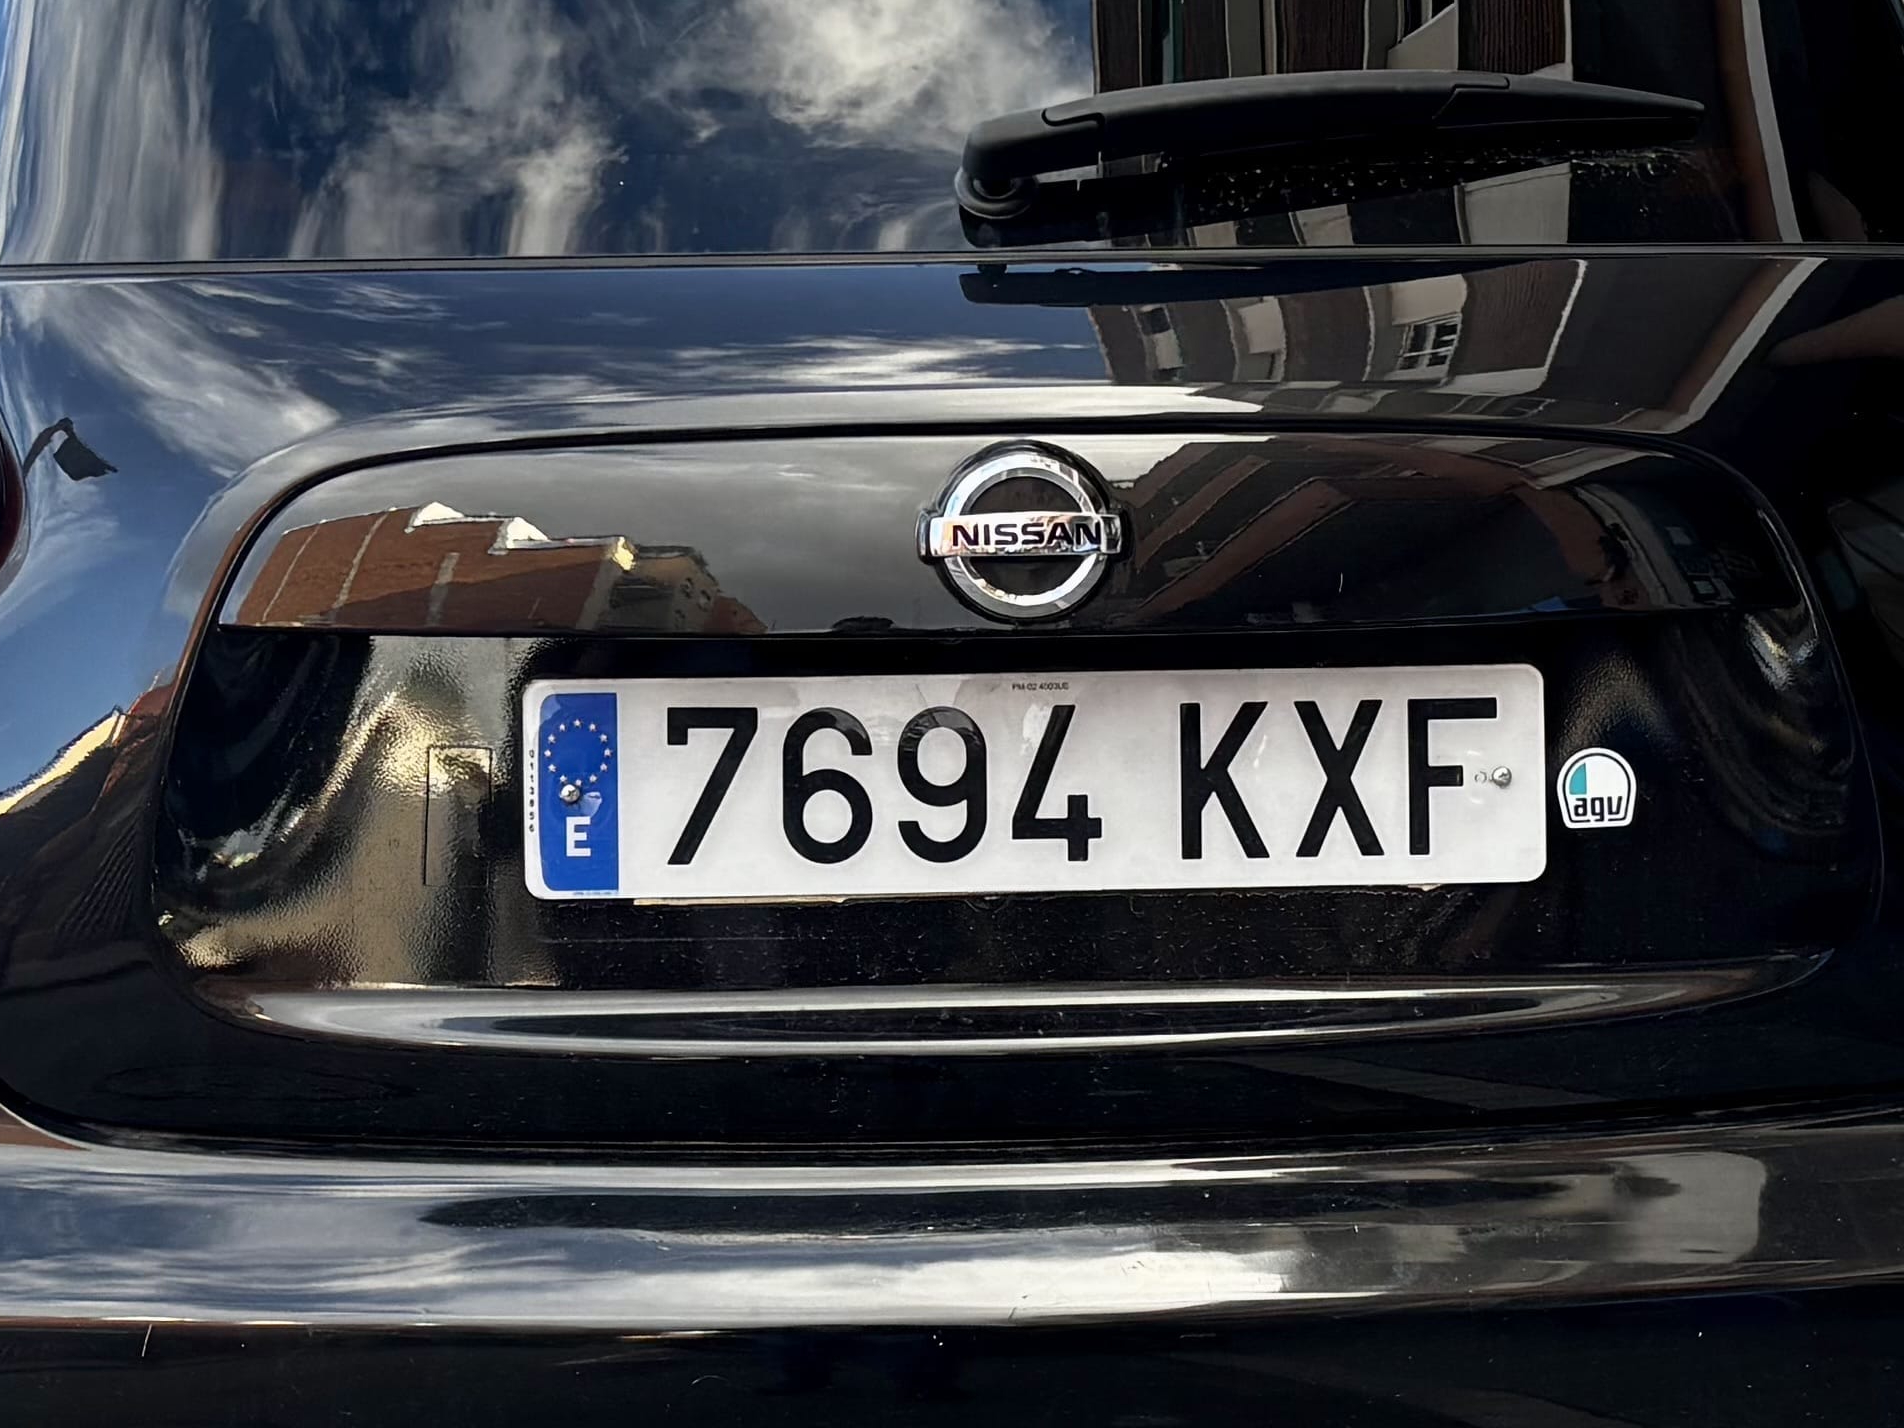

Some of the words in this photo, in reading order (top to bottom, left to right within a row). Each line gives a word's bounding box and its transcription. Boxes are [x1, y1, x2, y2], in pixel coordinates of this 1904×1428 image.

[952, 522, 1101, 547] NISSAN
[667, 705, 1102, 865] 7694
[1180, 697, 1498, 860] KXF
[1574, 795, 1623, 823] agv
[566, 816, 592, 858] E
